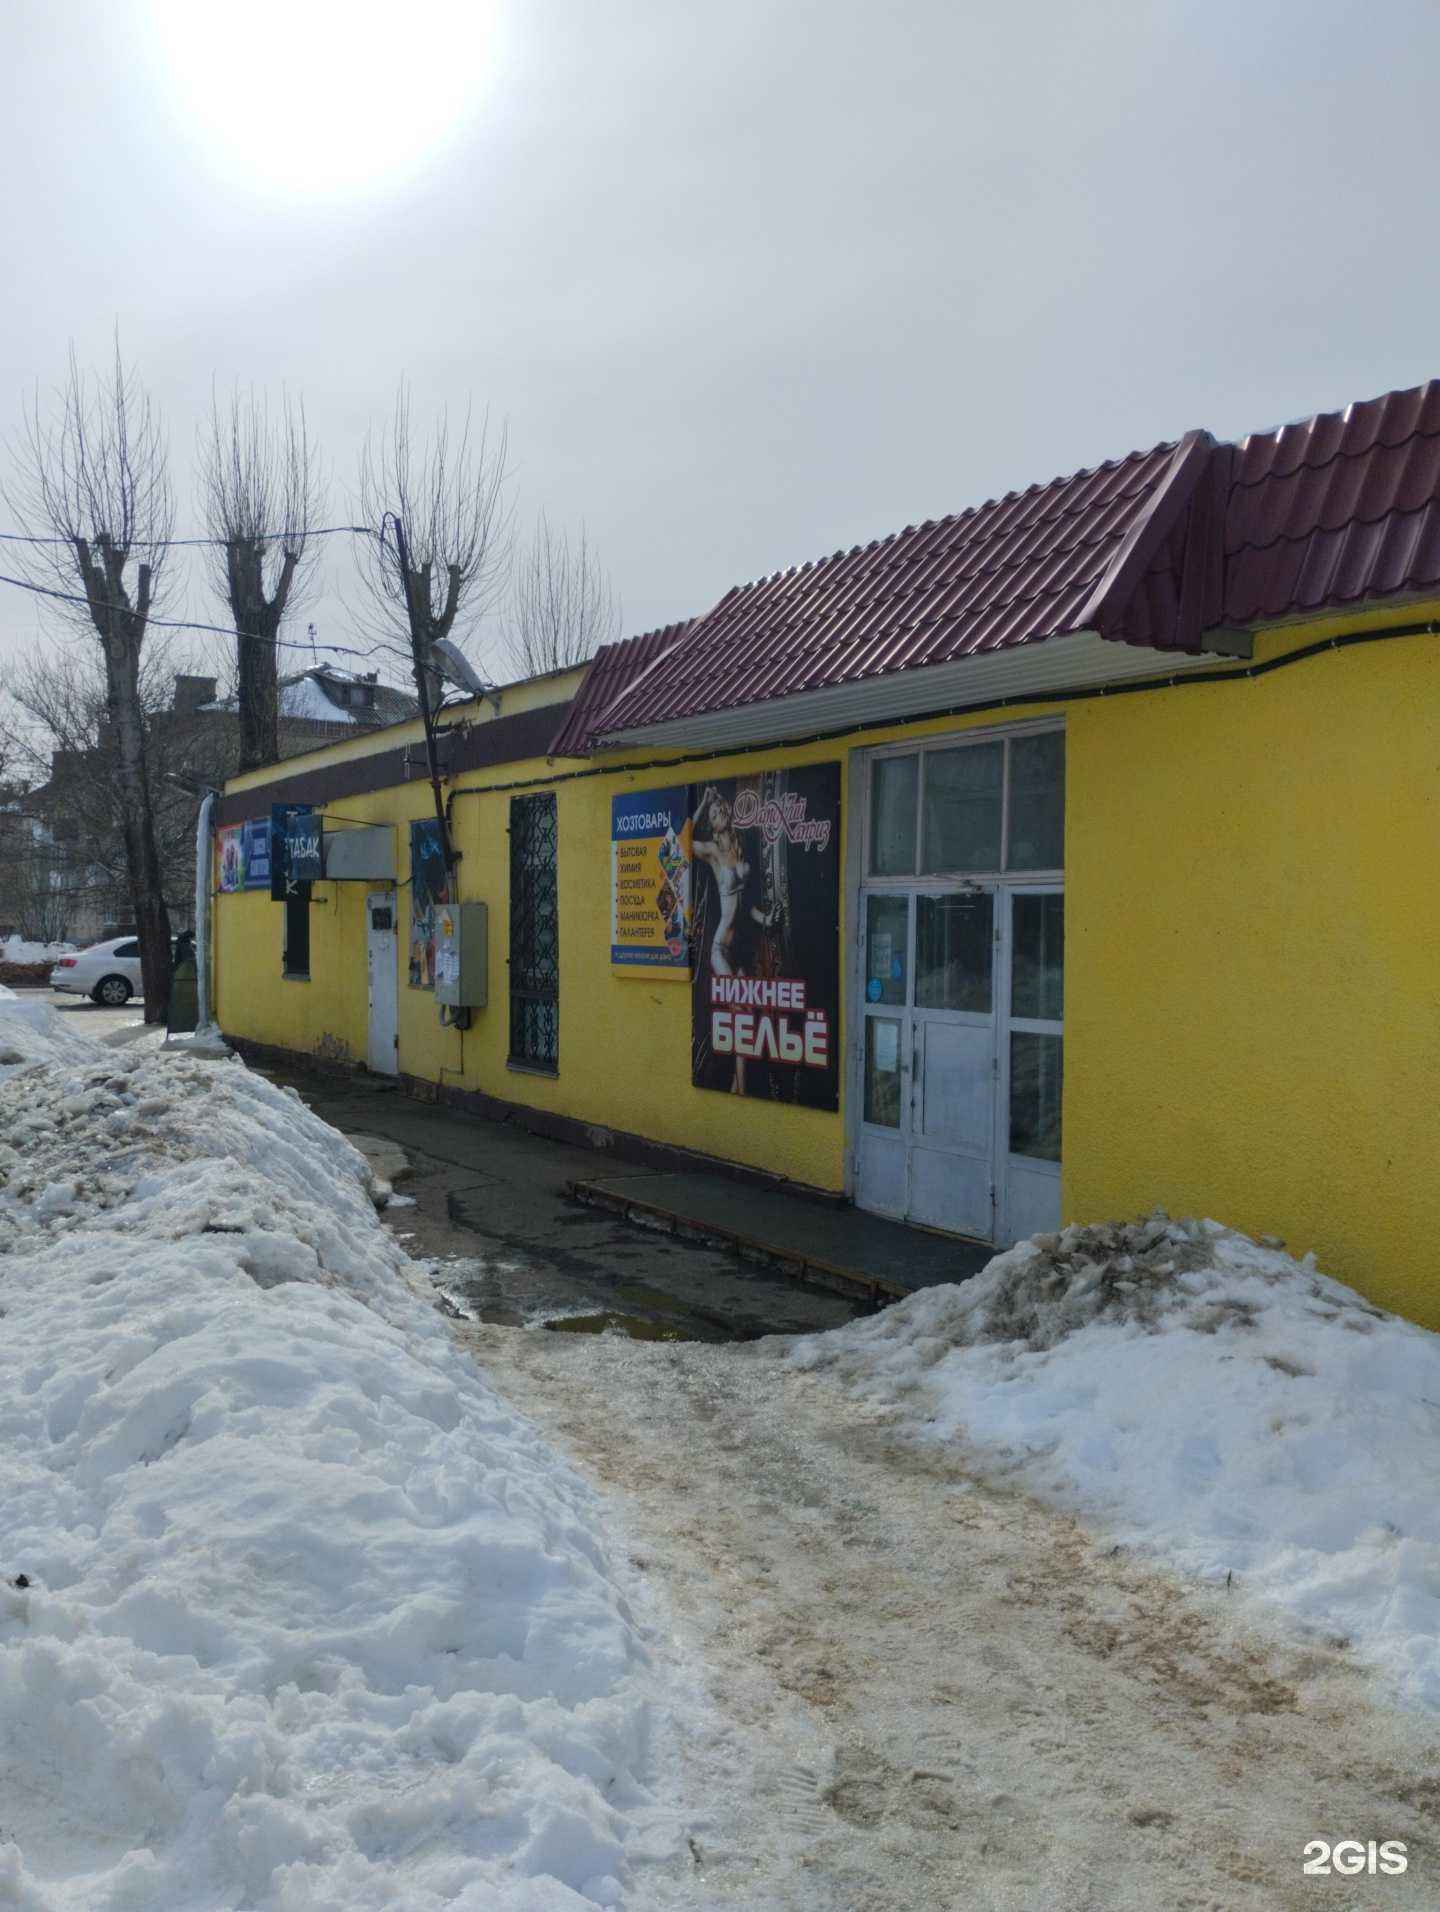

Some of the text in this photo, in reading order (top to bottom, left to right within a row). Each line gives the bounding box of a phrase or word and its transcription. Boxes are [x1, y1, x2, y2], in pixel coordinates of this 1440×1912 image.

[616, 811, 671, 832] ХОЗТОВАРЫ
[290, 836, 320, 859] ТАБАК
[620, 846, 648, 857] БЫТОВАЯ
[619, 862, 642, 873] ХИМИЯ
[620, 879, 657, 889] КОСМЕТИКА
[620, 895, 646, 905] ПОСУДА
[620, 927, 656, 938] ГАЛАНТЕРЕЯ
[712, 977, 805, 1009] НИЖНЕЕ
[712, 1011, 828, 1066] БЕЛЬЁ
